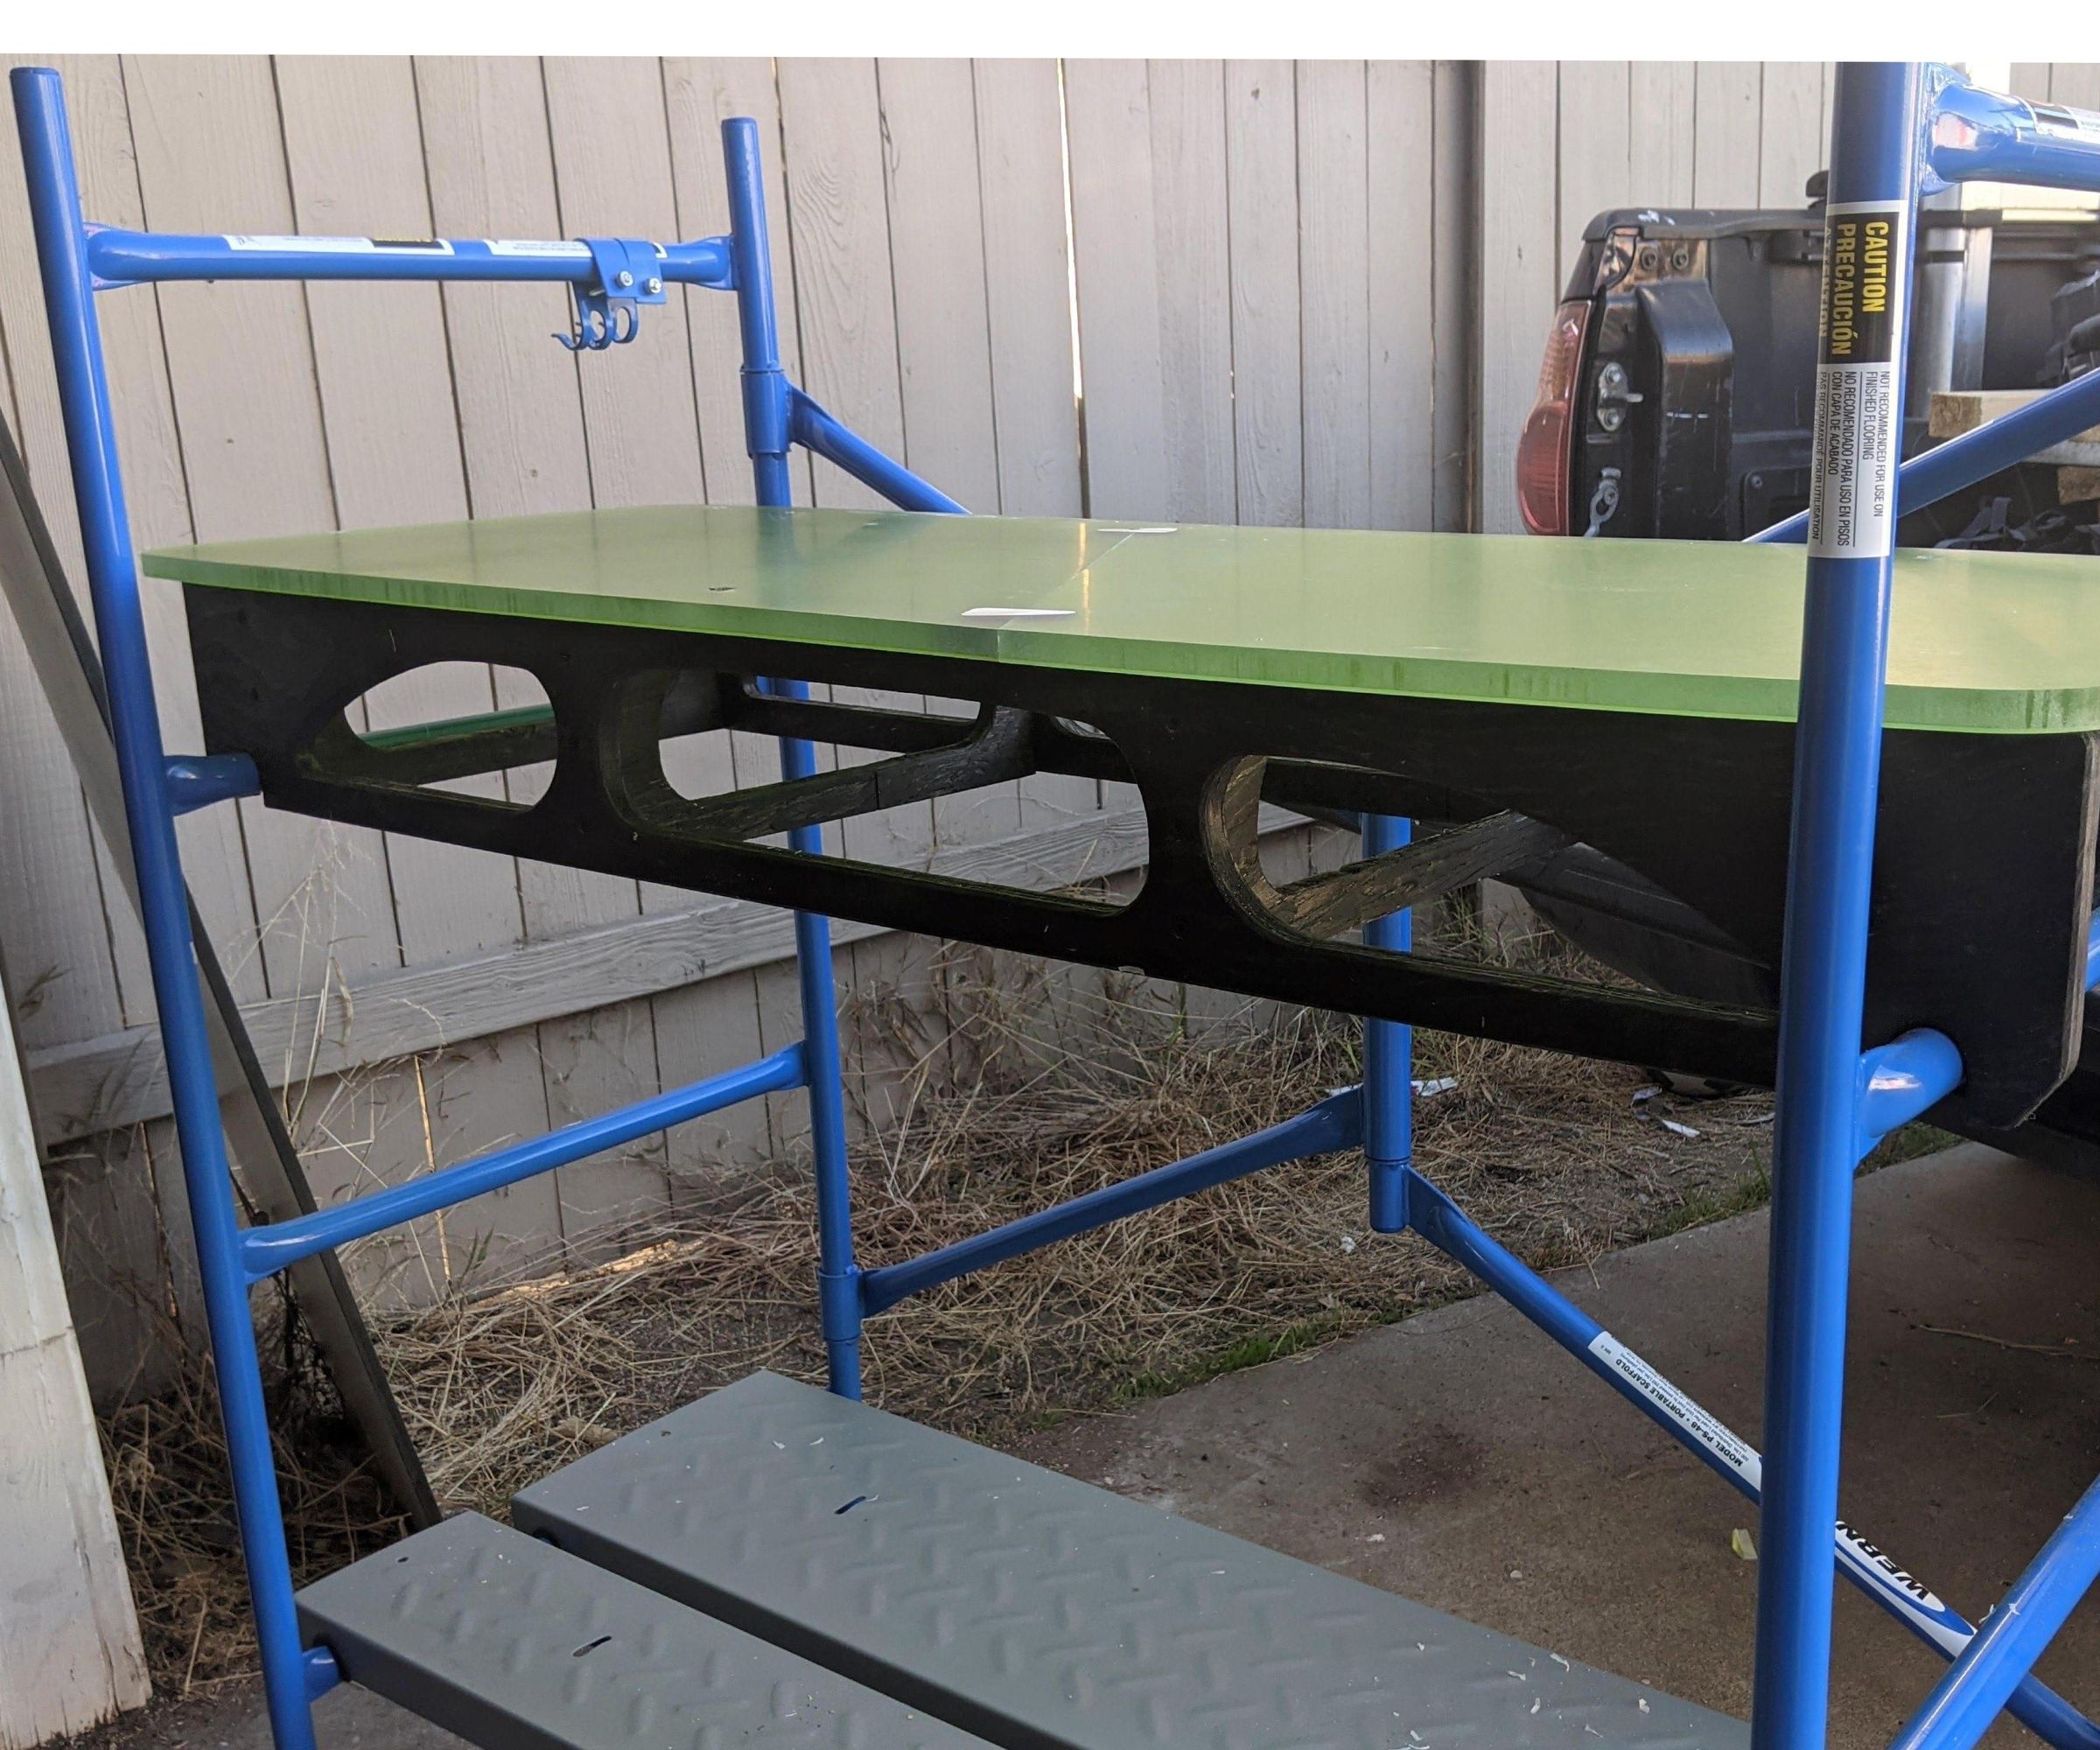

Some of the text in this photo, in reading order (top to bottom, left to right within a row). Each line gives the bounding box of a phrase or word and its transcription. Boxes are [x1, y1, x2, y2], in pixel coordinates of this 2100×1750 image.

[1819, 228, 1831, 337] ATTENTION
[1831, 223, 1858, 354] PRECAUCIÓN
[1862, 221, 1889, 312] CAUTION
[1816, 392, 1826, 456] RECOMMANDÉ
[1828, 371, 1843, 475] CON CAPA DE ACABADO
[1838, 371, 1857, 546] NO RECOMENDADO PARA USO EN PISOS
[1862, 371, 1879, 460] FINISHED FLOORING
[1873, 371, 1890, 517] NOT RECOMMENDED FOR USE ON
[1812, 486, 1822, 540] UTILISATION
[1616, 1358, 1651, 1390] SCAFFOLD
[1650, 1387, 1686, 1418] PORTABLE
[1691, 1421, 1714, 1443] PS-48
[1715, 1440, 1744, 1467] MODEL
